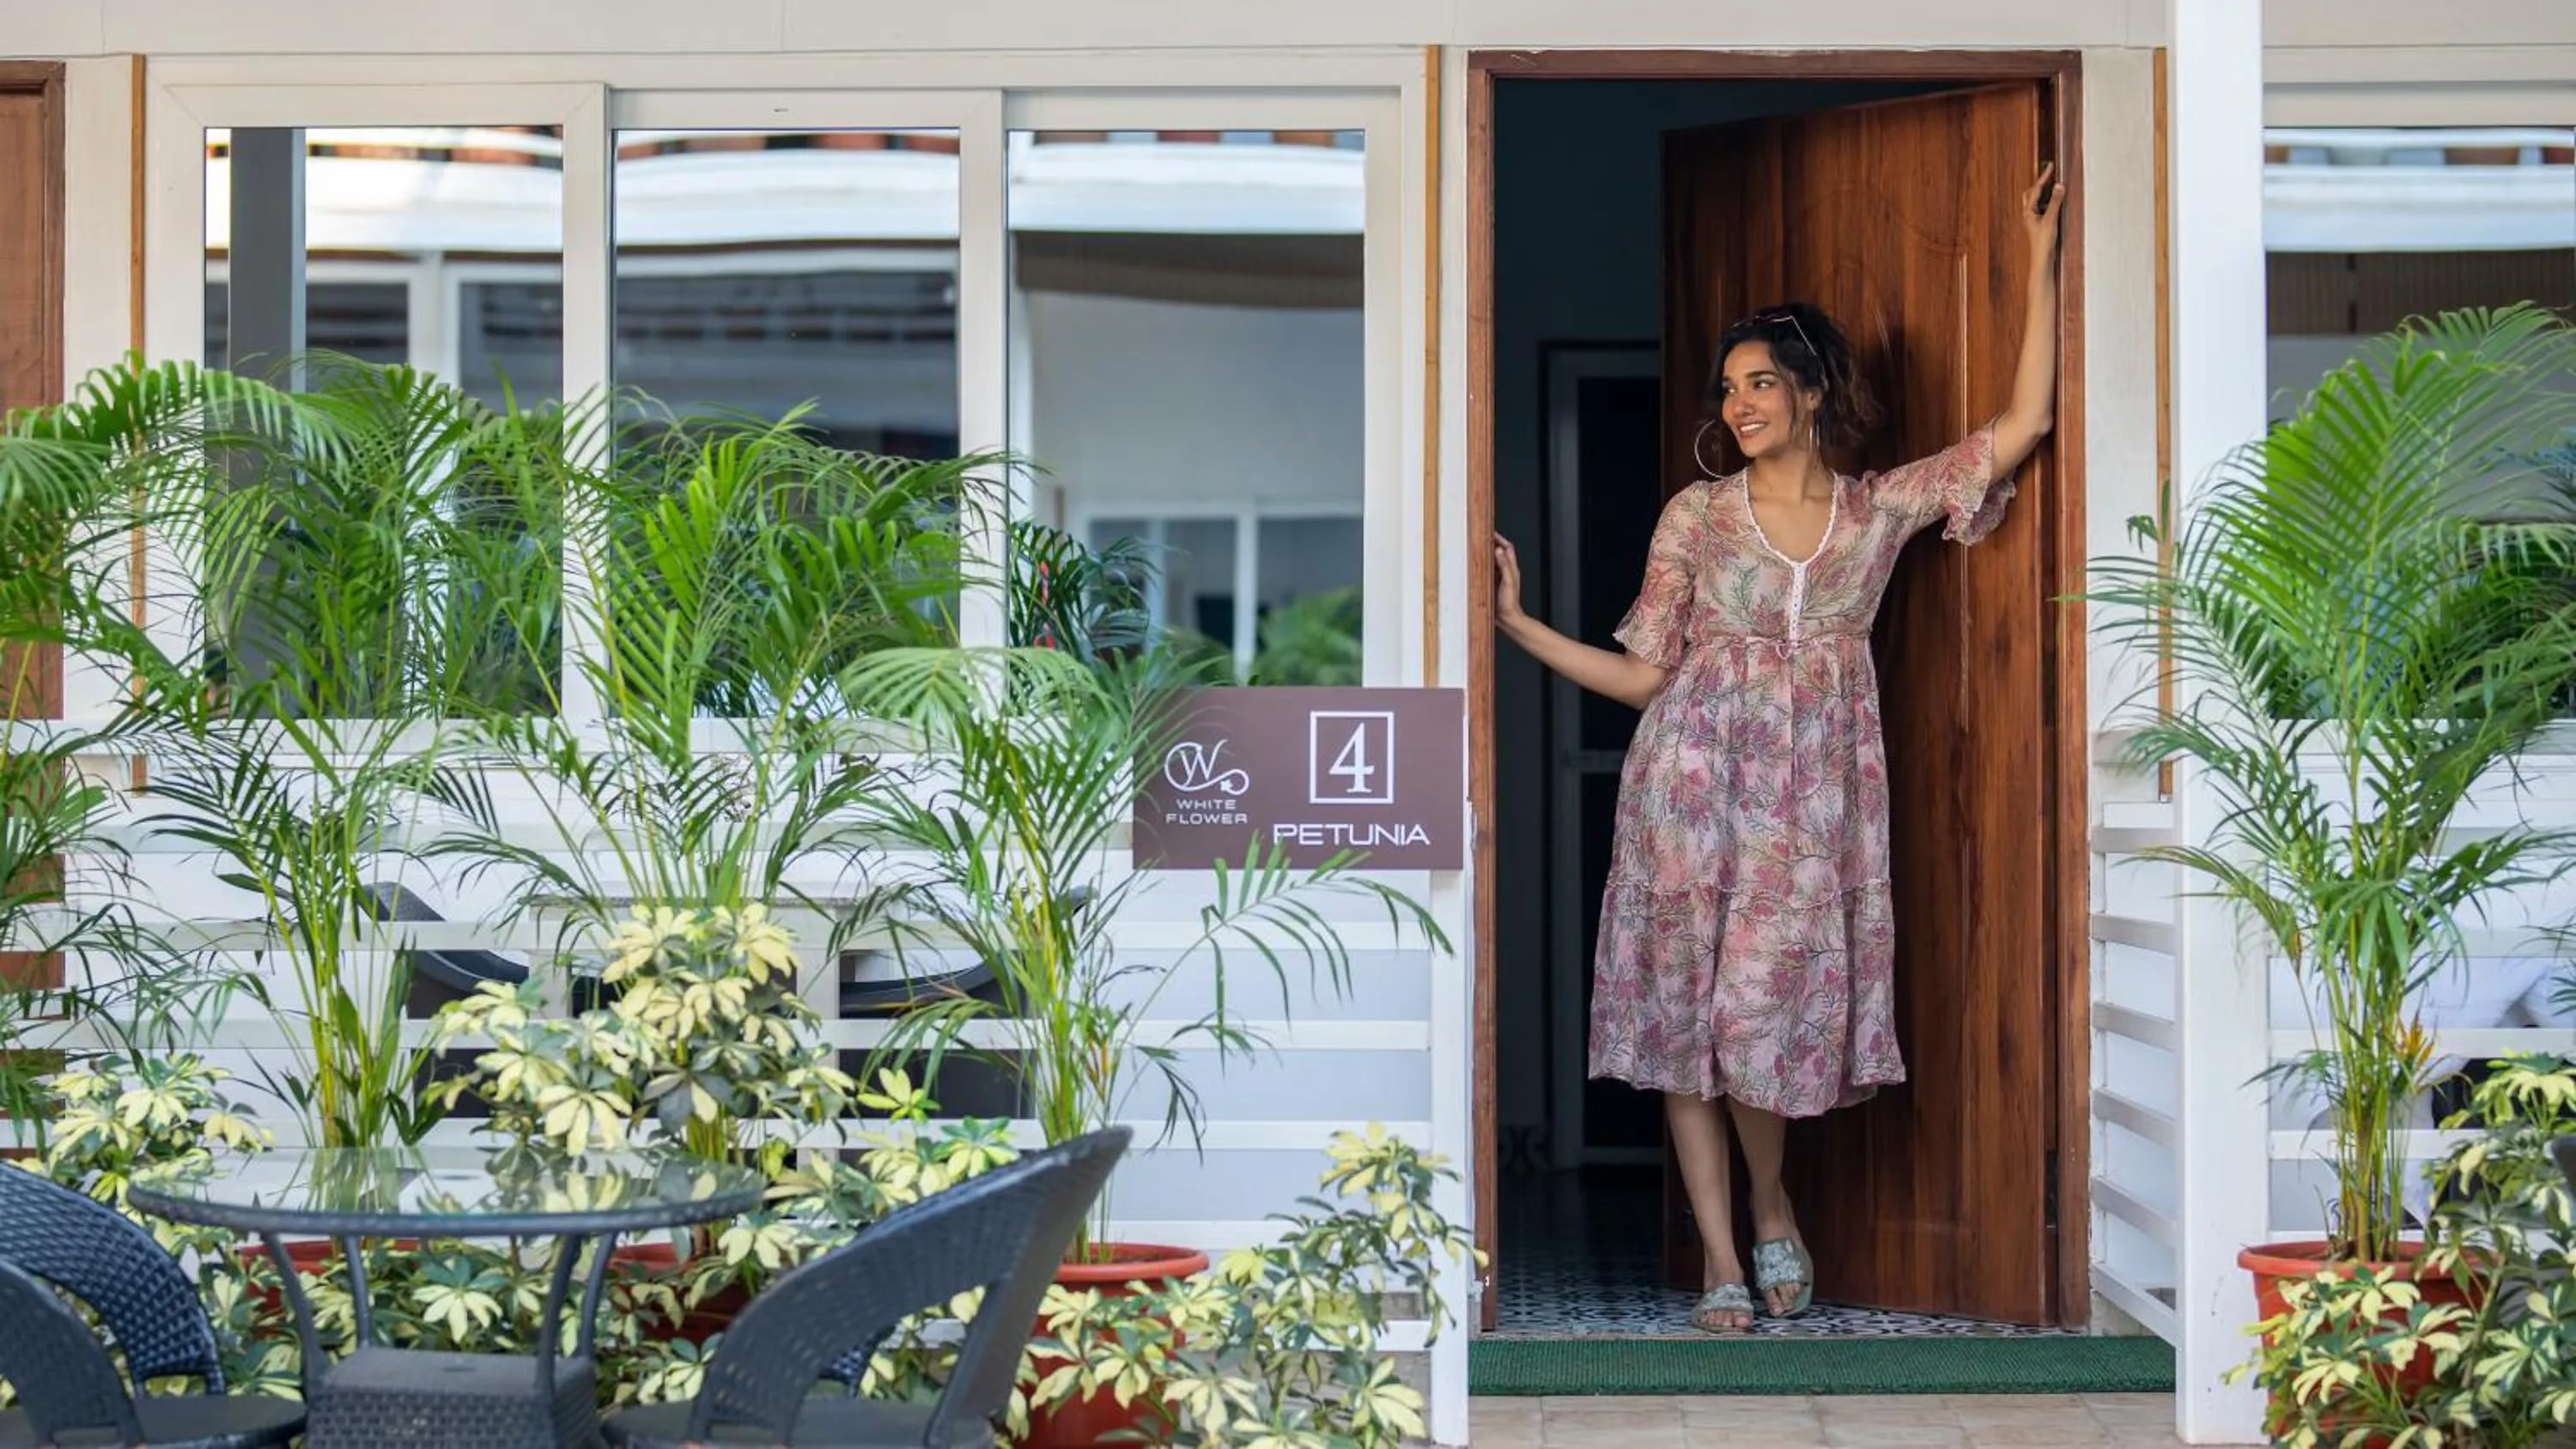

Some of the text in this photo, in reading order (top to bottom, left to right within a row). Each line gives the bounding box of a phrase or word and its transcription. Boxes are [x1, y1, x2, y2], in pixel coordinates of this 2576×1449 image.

[1328, 722, 1375, 793] 4
[1176, 798, 1236, 810] WHITE
[1165, 813, 1248, 824] FLOWER
[1273, 823, 1431, 846] PETUNIA
